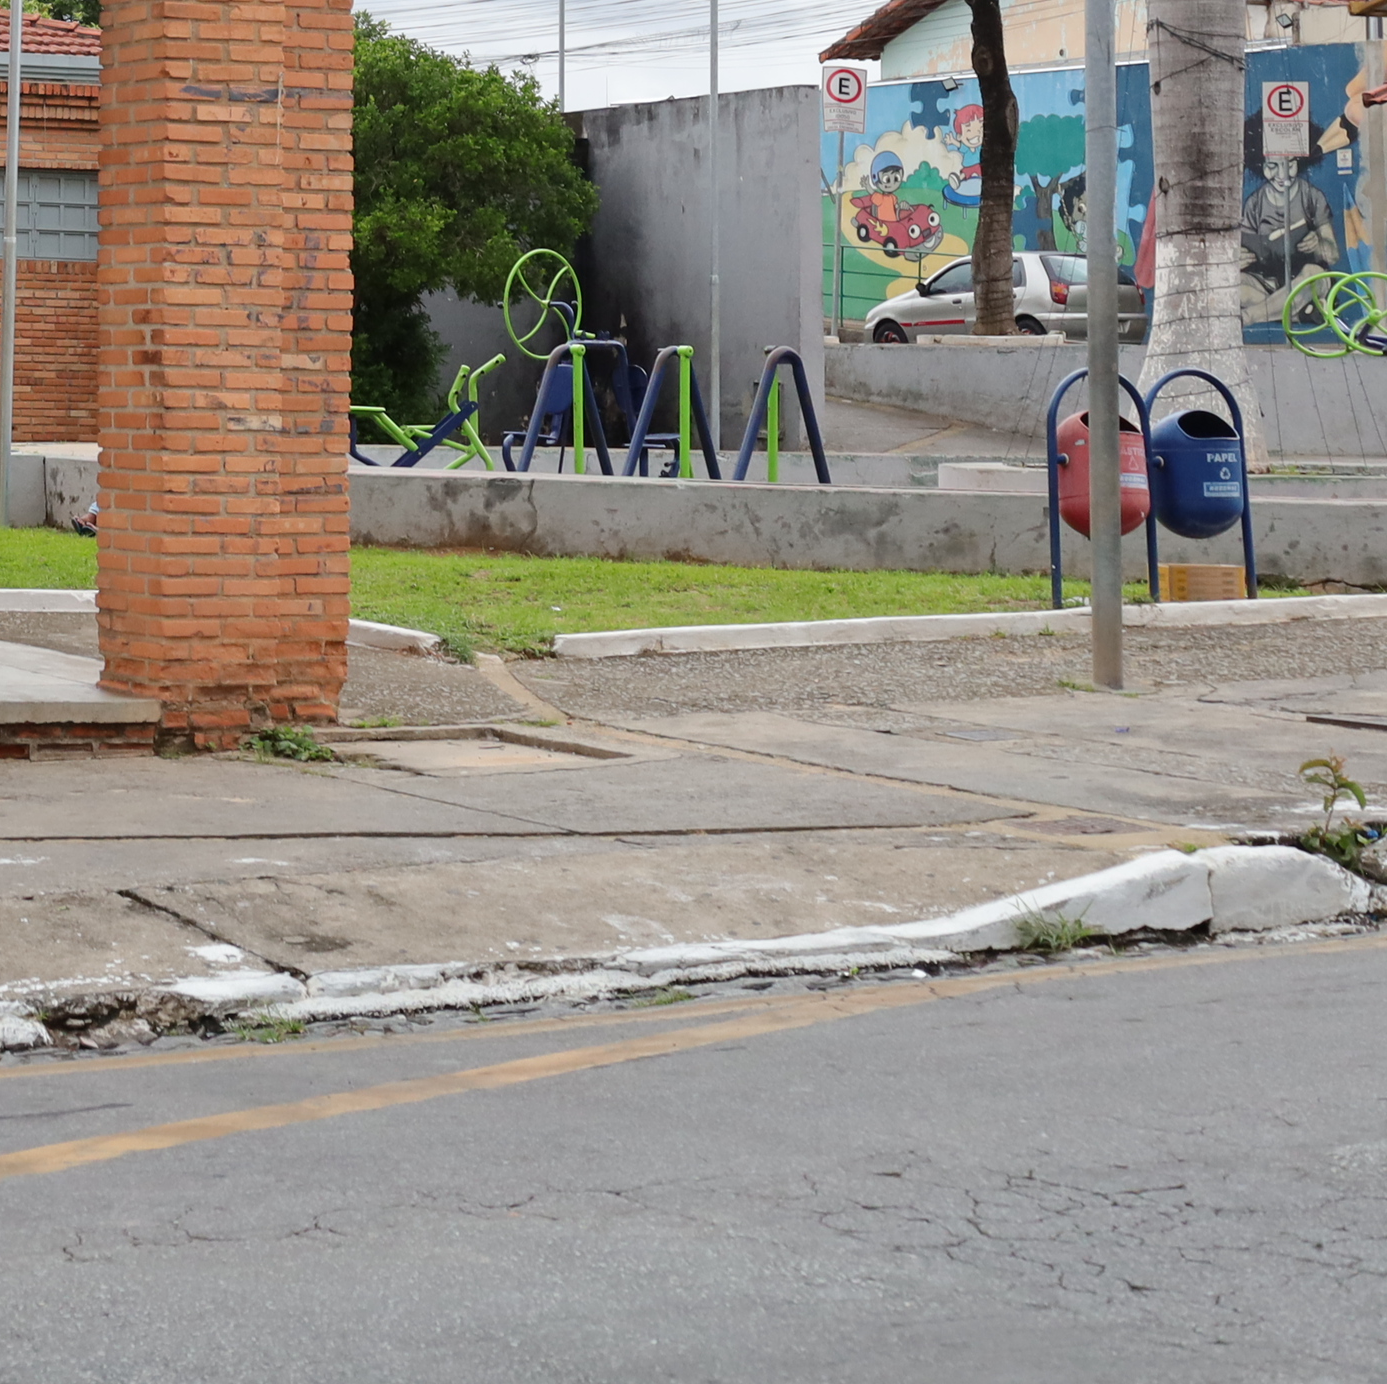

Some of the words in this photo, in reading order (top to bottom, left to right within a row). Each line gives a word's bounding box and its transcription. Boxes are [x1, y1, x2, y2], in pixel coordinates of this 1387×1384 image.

[838, 77, 851, 96] E
[1278, 90, 1293, 112] E
[1206, 452, 1238, 463] PAPEL
